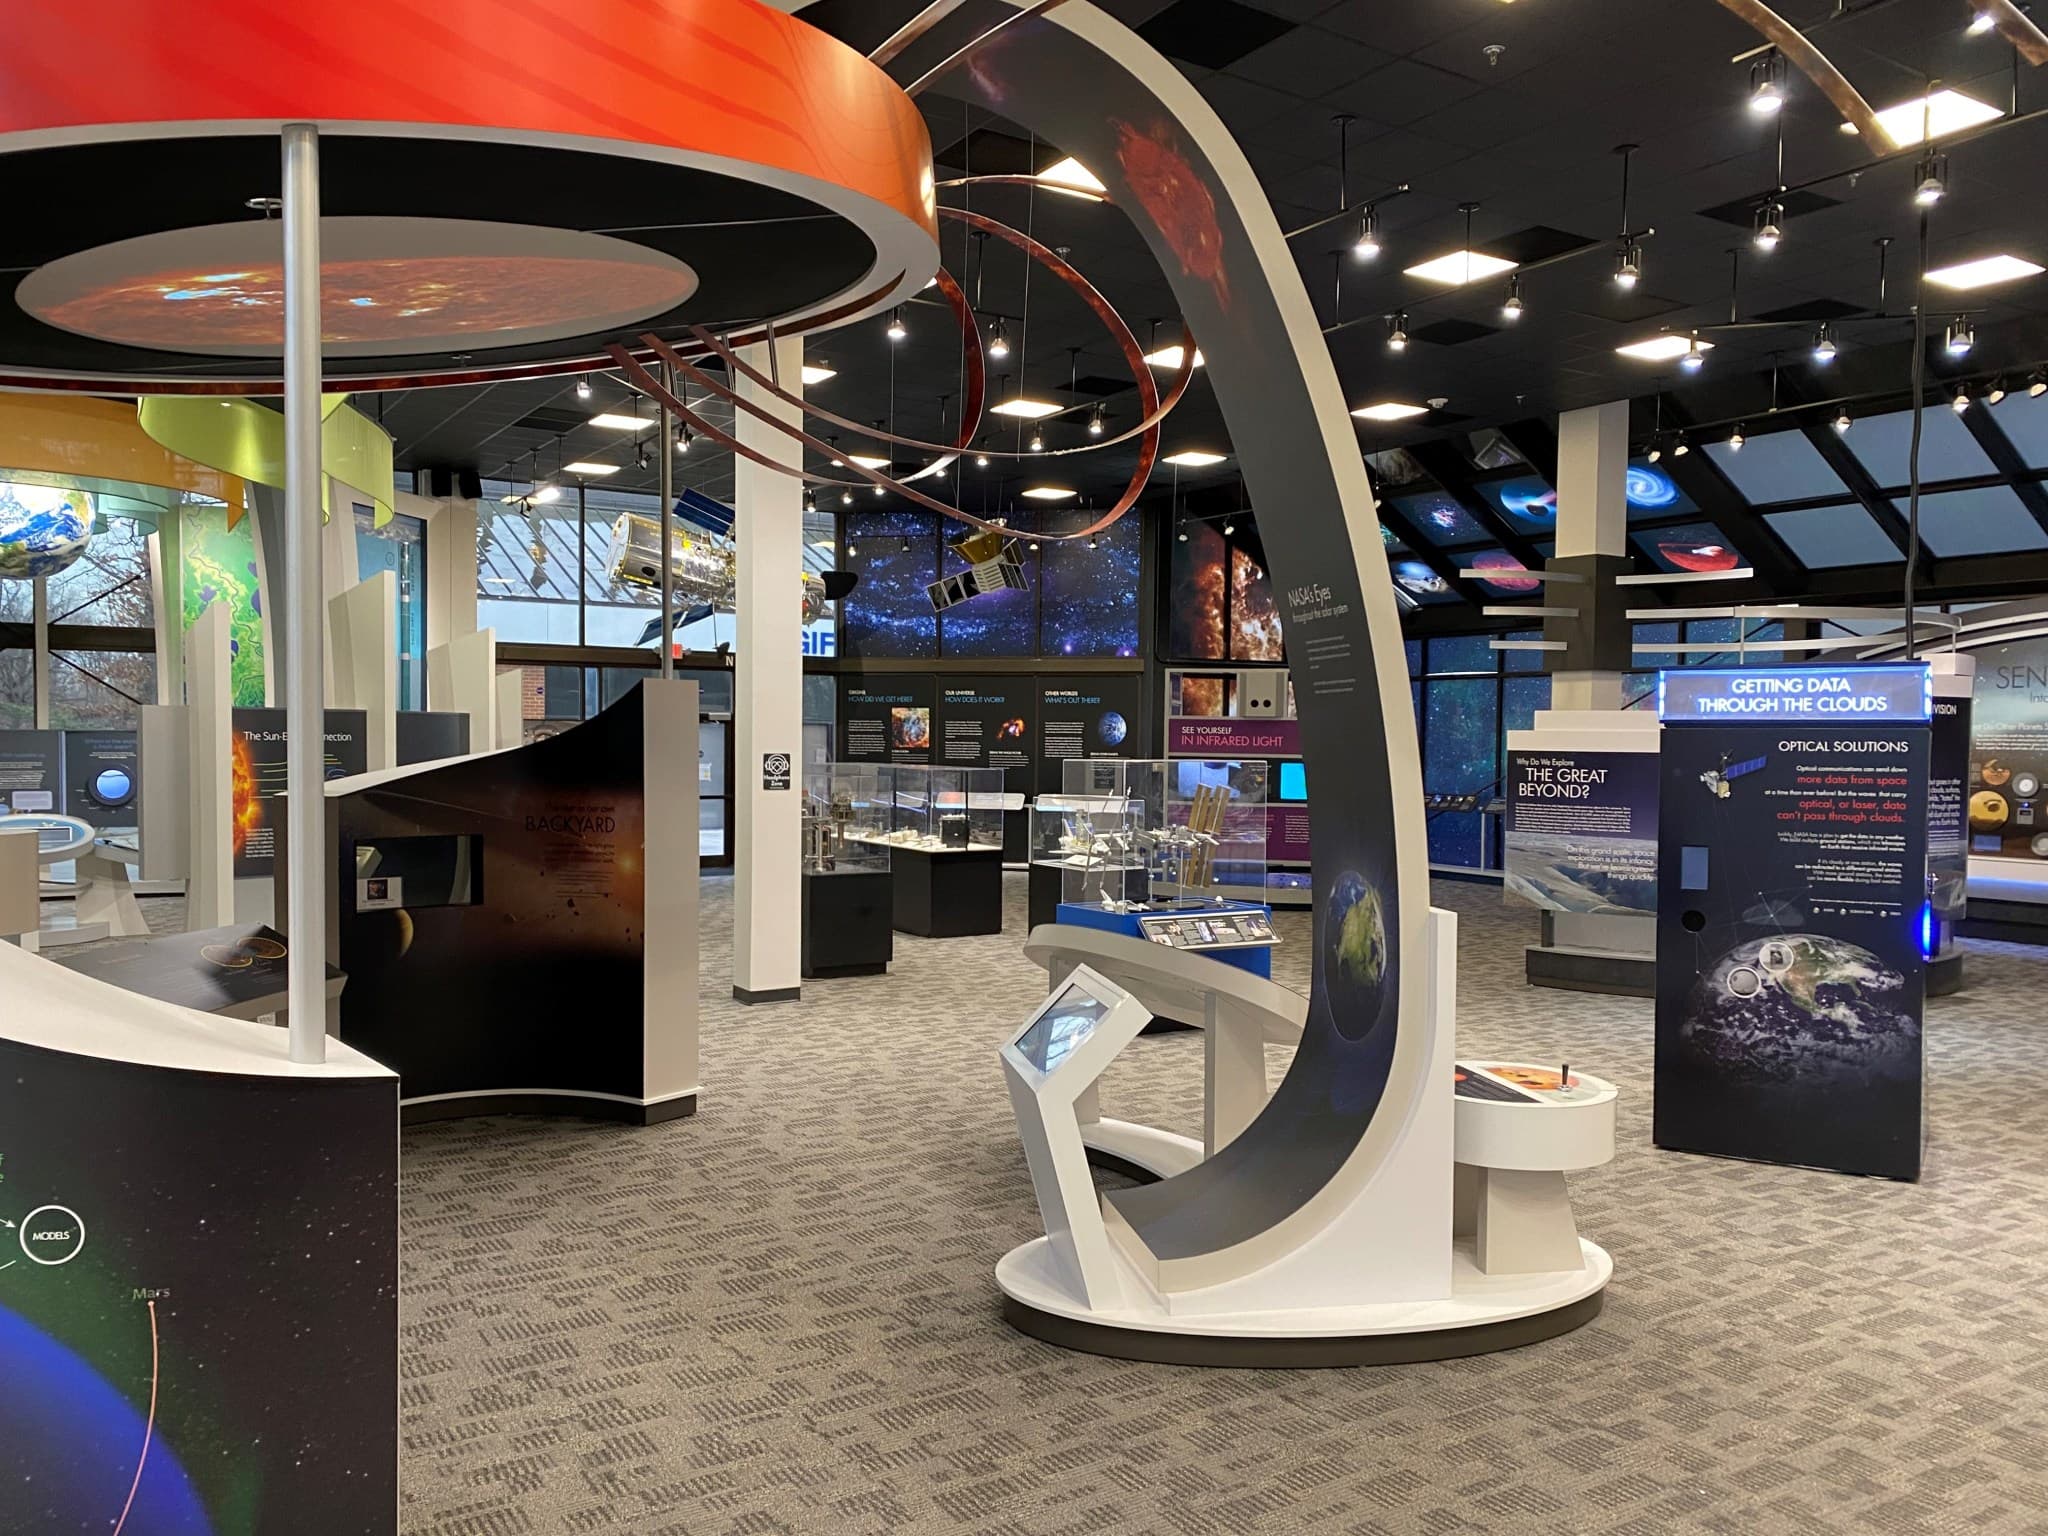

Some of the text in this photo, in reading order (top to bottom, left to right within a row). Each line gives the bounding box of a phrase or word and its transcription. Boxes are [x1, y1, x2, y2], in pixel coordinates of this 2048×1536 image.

[1288, 584, 1332, 608] NASA's Eyes
[1732, 678, 1851, 694] GETTING DATA
[1698, 696, 1888, 712] THROUGH THE CLOUDS
[243, 731, 260, 741] The
[263, 731, 288, 741] Sun-E
[1182, 726, 1232, 735] SEE YOURSELF
[1182, 736, 1284, 748] IN INFRARED LIGHT
[1778, 741, 1909, 753] OPTICAL SOLUTIONS
[1516, 758, 1529, 766] Why
[1552, 759, 1575, 767] Explore
[1525, 768, 1608, 784] THE GREAT
[1824, 775, 1848, 784] data
[1850, 774, 1874, 784] from
[1876, 778, 1908, 787] space
[1519, 783, 1590, 799] BEYOND?
[1799, 800, 1835, 810] optical,
[1852, 800, 1878, 810] laser,
[1883, 800, 1906, 810] data
[1777, 811, 1904, 824] can't pass through clouds.
[526, 816, 616, 833] BACKYARD
[1566, 844, 1578, 853] On
[1591, 847, 1612, 856] grand
[32, 1231, 70, 1241] MODELS
[132, 1288, 170, 1300] Mars
